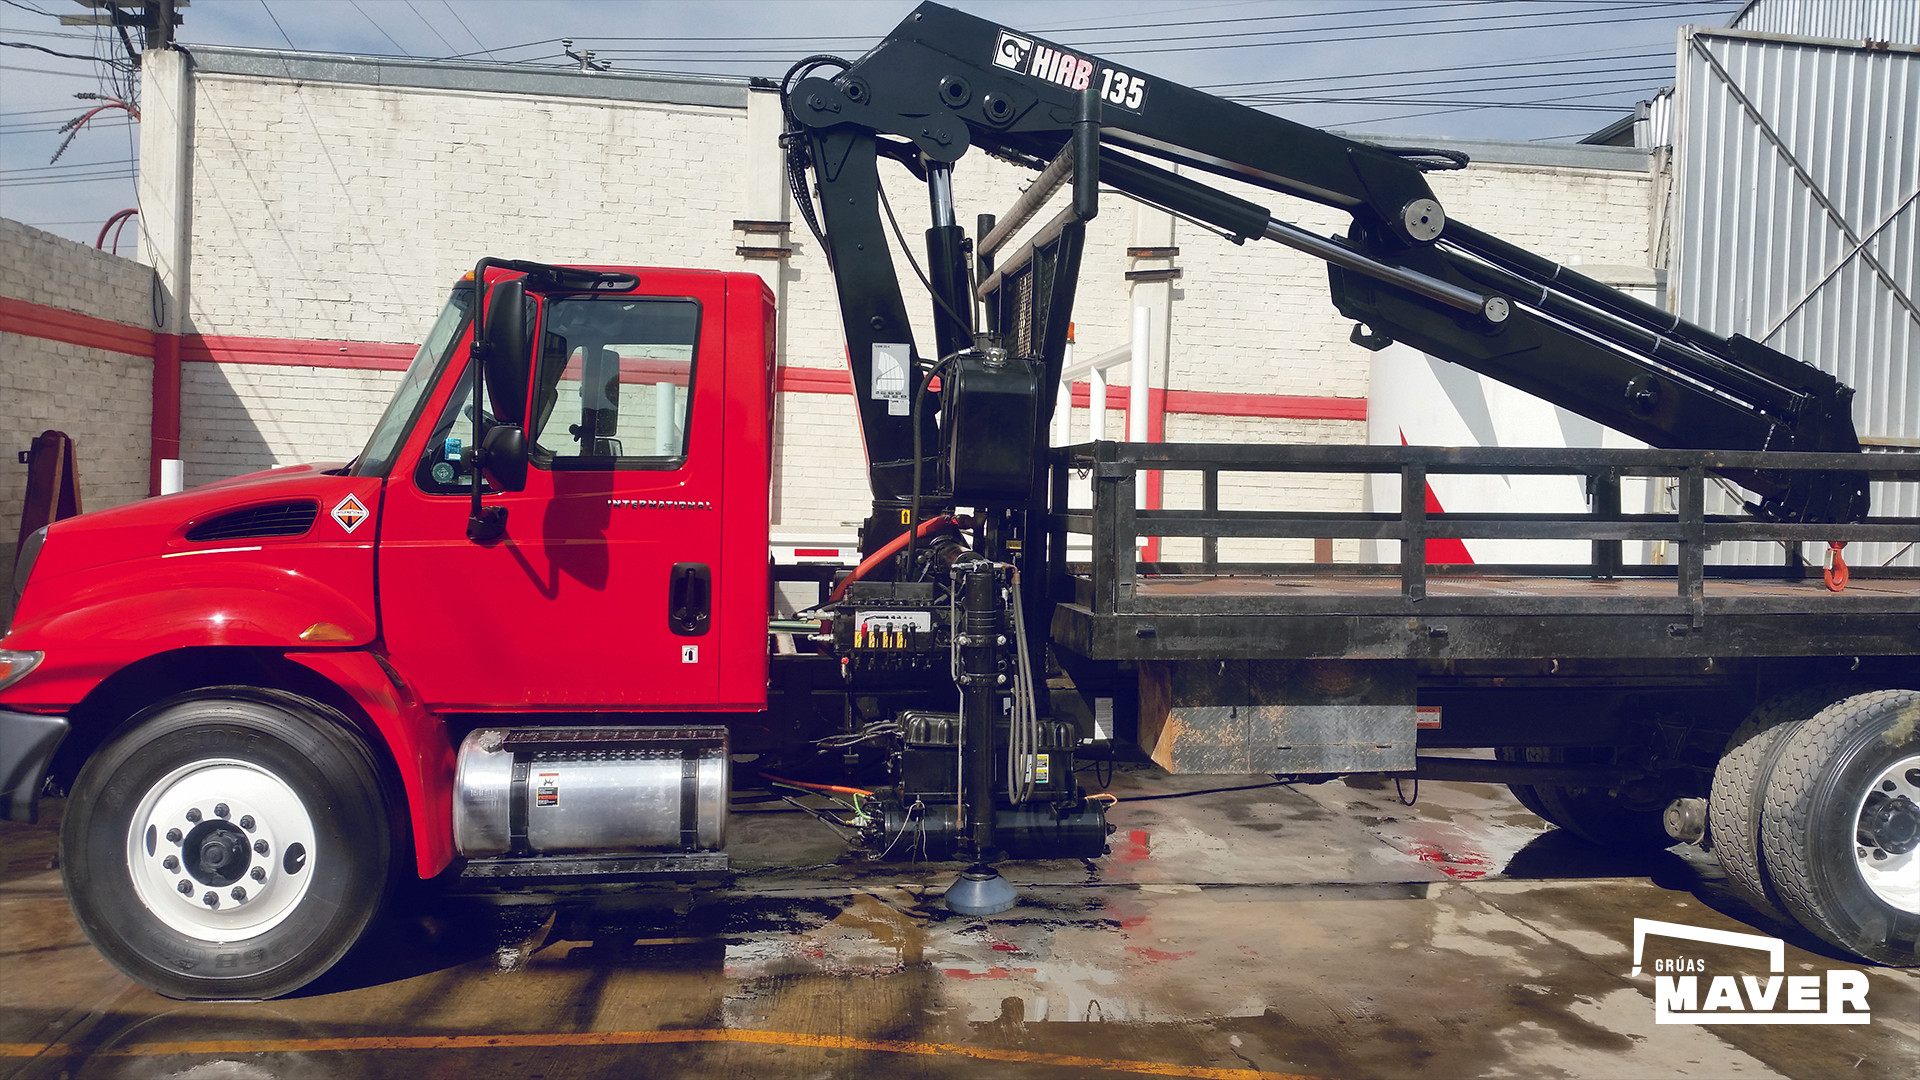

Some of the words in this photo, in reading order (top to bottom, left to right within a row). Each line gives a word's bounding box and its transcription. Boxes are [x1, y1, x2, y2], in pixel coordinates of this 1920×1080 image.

[1030, 45, 1094, 91] HIAB
[1101, 68, 1146, 109] 135
[607, 499, 712, 510] INTERNATIONAL
[106, 728, 260, 812] BRGESTONE
